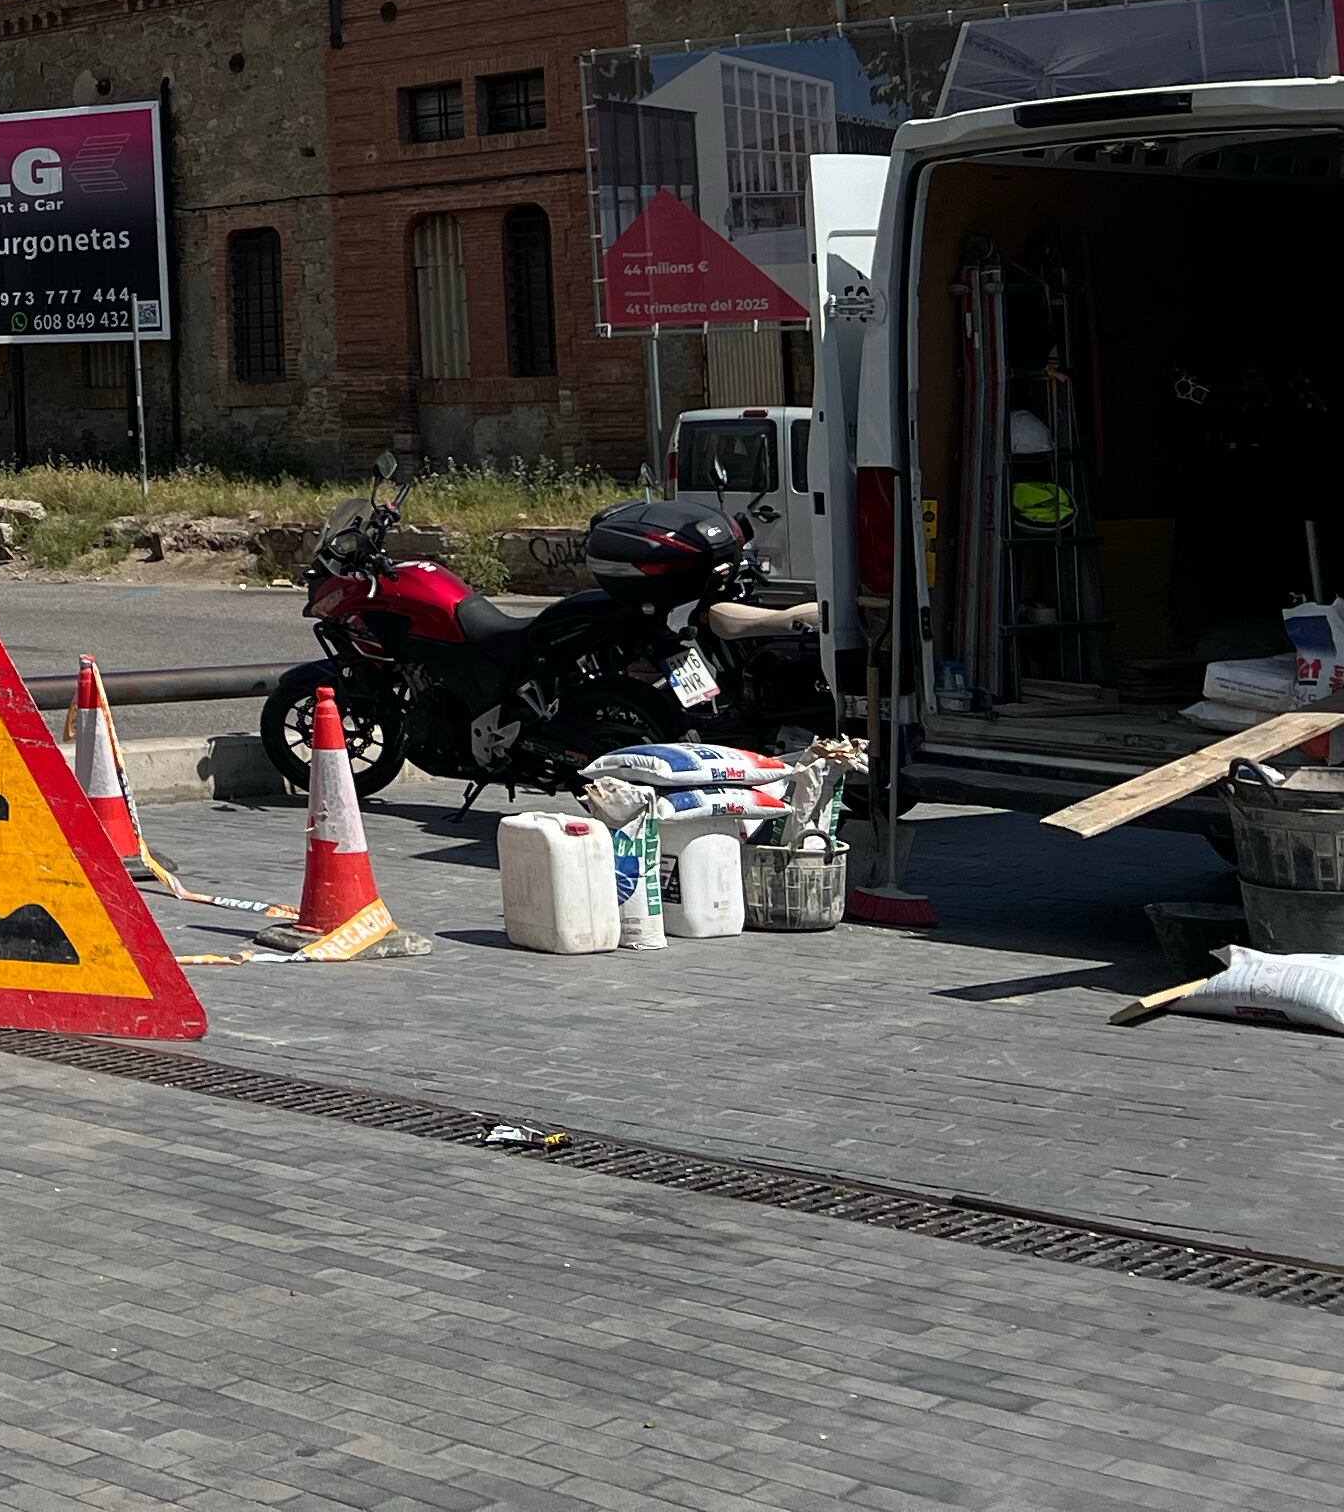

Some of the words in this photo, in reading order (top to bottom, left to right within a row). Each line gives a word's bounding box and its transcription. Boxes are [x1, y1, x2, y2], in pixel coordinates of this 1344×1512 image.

[19, 203, 29, 213] a
[34, 197, 64, 213] Car
[624, 264, 641, 275] 44
[645, 262, 694, 275] milions
[697, 261, 709, 272] €
[0, 290, 35, 307] 973
[45, 289, 81, 306] 777
[92, 287, 130, 303] 444
[626, 304, 640, 315] 4t
[644, 301, 706, 314] trimestre
[711, 299, 732, 311] del
[736, 298, 769, 310] 2025
[33, 313, 64, 330] 608
[66, 312, 96, 330] 849
[99, 311, 130, 328] 432
[680, 673, 706, 694] HVR
